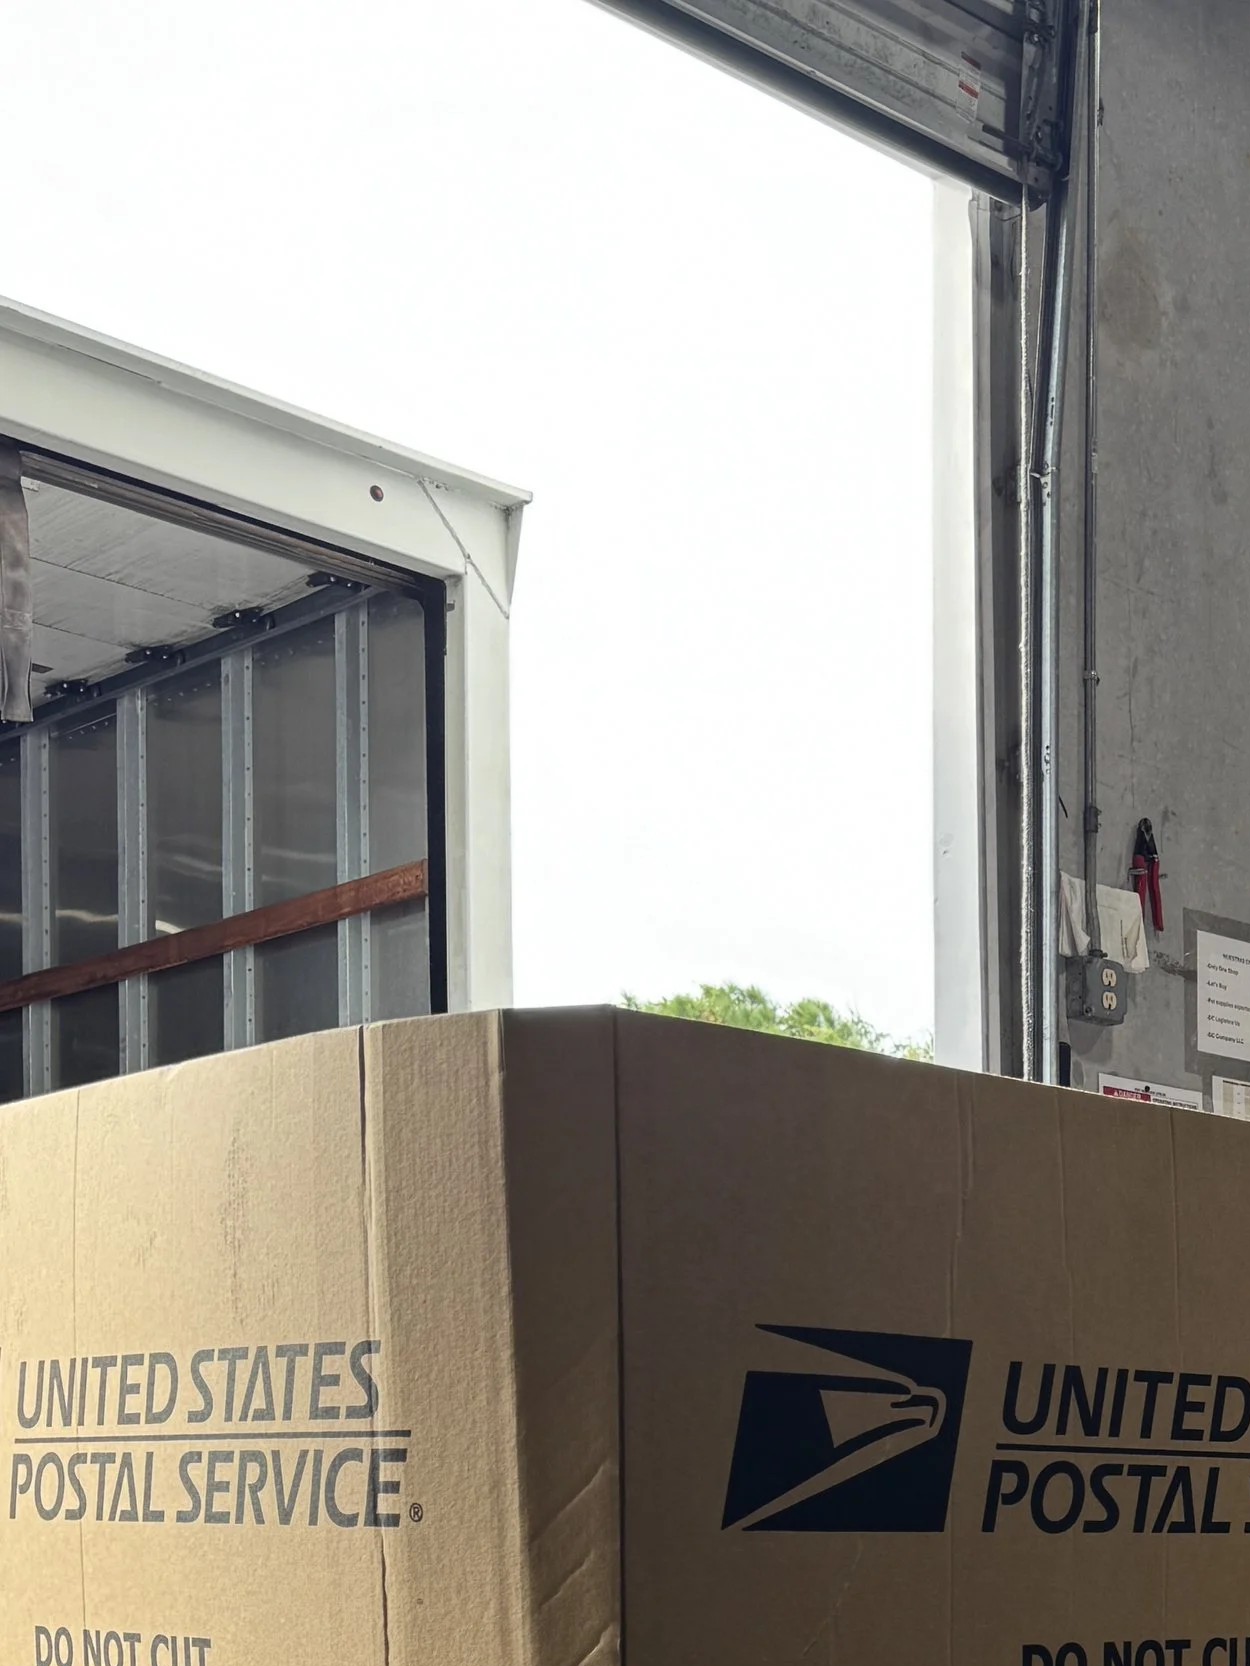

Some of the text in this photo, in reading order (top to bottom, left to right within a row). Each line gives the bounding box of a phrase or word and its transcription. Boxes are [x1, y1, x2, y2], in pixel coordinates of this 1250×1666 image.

[17, 1340, 381, 1429] UNITED STATES
[9, 1451, 164, 1522] POSTAL
[981, 1459, 1231, 1535] POSTAL
